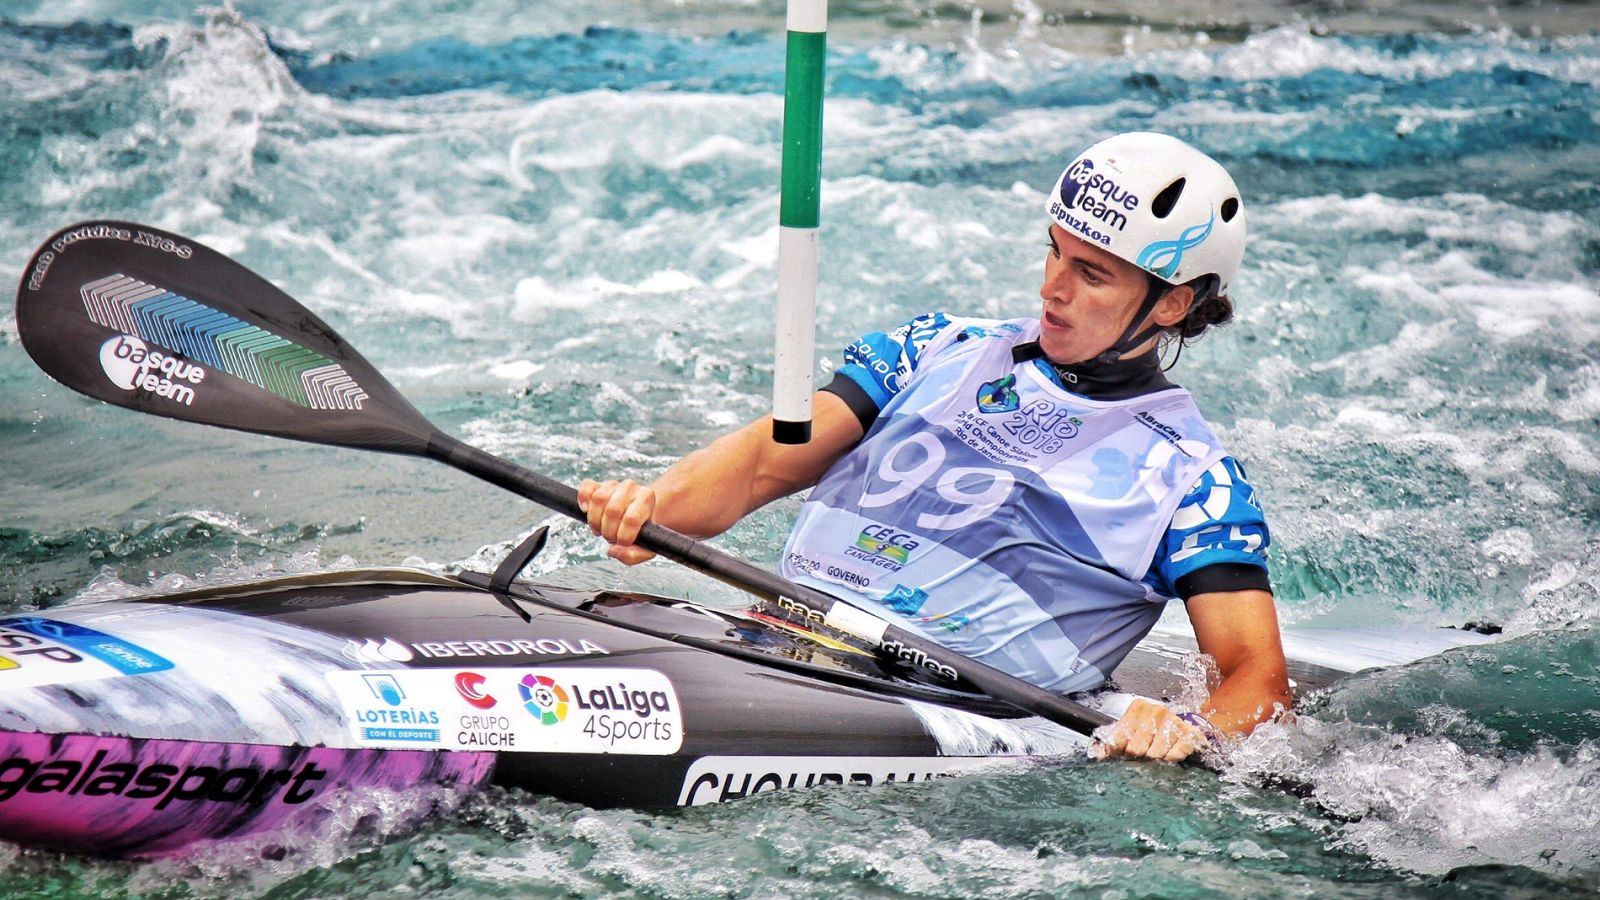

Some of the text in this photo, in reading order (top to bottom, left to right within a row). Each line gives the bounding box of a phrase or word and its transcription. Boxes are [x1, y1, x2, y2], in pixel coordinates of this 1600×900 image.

[1068, 160, 1139, 211] basque
[1049, 201, 1111, 246] gipuzkoa
[1070, 184, 1128, 231] team
[114, 335, 204, 384] basque
[131, 366, 194, 406] team
[954, 426, 968, 440] Rio
[967, 438, 979, 448] de
[986, 425, 1011, 448] Canoe
[1002, 412, 1064, 454] 2018
[1138, 411, 1182, 441] ABraCan
[857, 431, 1015, 530] 99
[827, 565, 870, 587] GOVERNO
[0, 629, 83, 663] SP
[411, 638, 610, 658] IBERDROLA
[572, 682, 670, 718] LaLiga
[369, 730, 433, 739] CON EL DEPORTE
[457, 731, 515, 746] CALICHE
[460, 715, 510, 730] GRUPO
[582, 714, 672, 746] 4Sports
[0, 750, 326, 810] galasport
